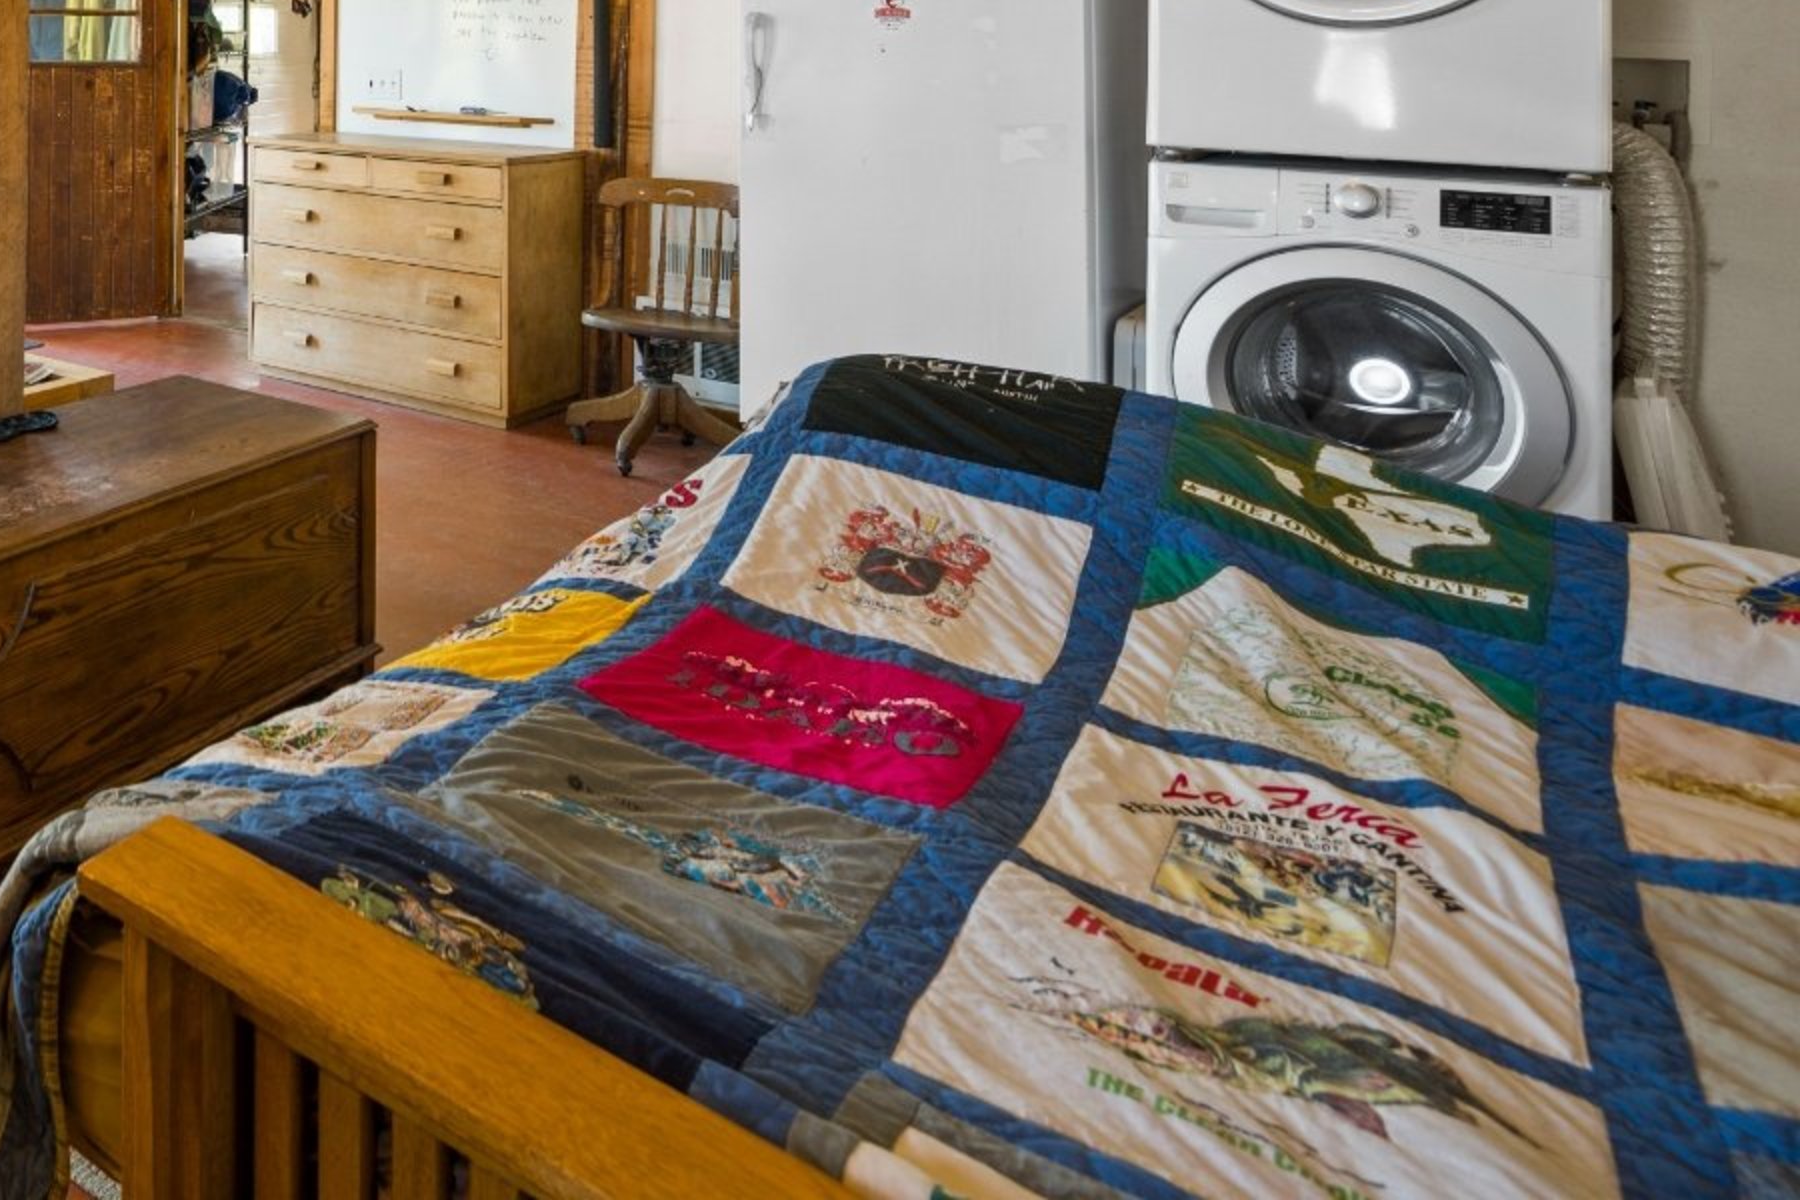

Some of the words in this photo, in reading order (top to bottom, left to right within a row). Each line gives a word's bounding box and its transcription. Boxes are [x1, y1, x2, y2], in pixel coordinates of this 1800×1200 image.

[1403, 572, 1488, 601] STATE
[1162, 773, 1245, 808] La
[1258, 785, 1424, 849] Feria
[1087, 1065, 1146, 1101] THE
